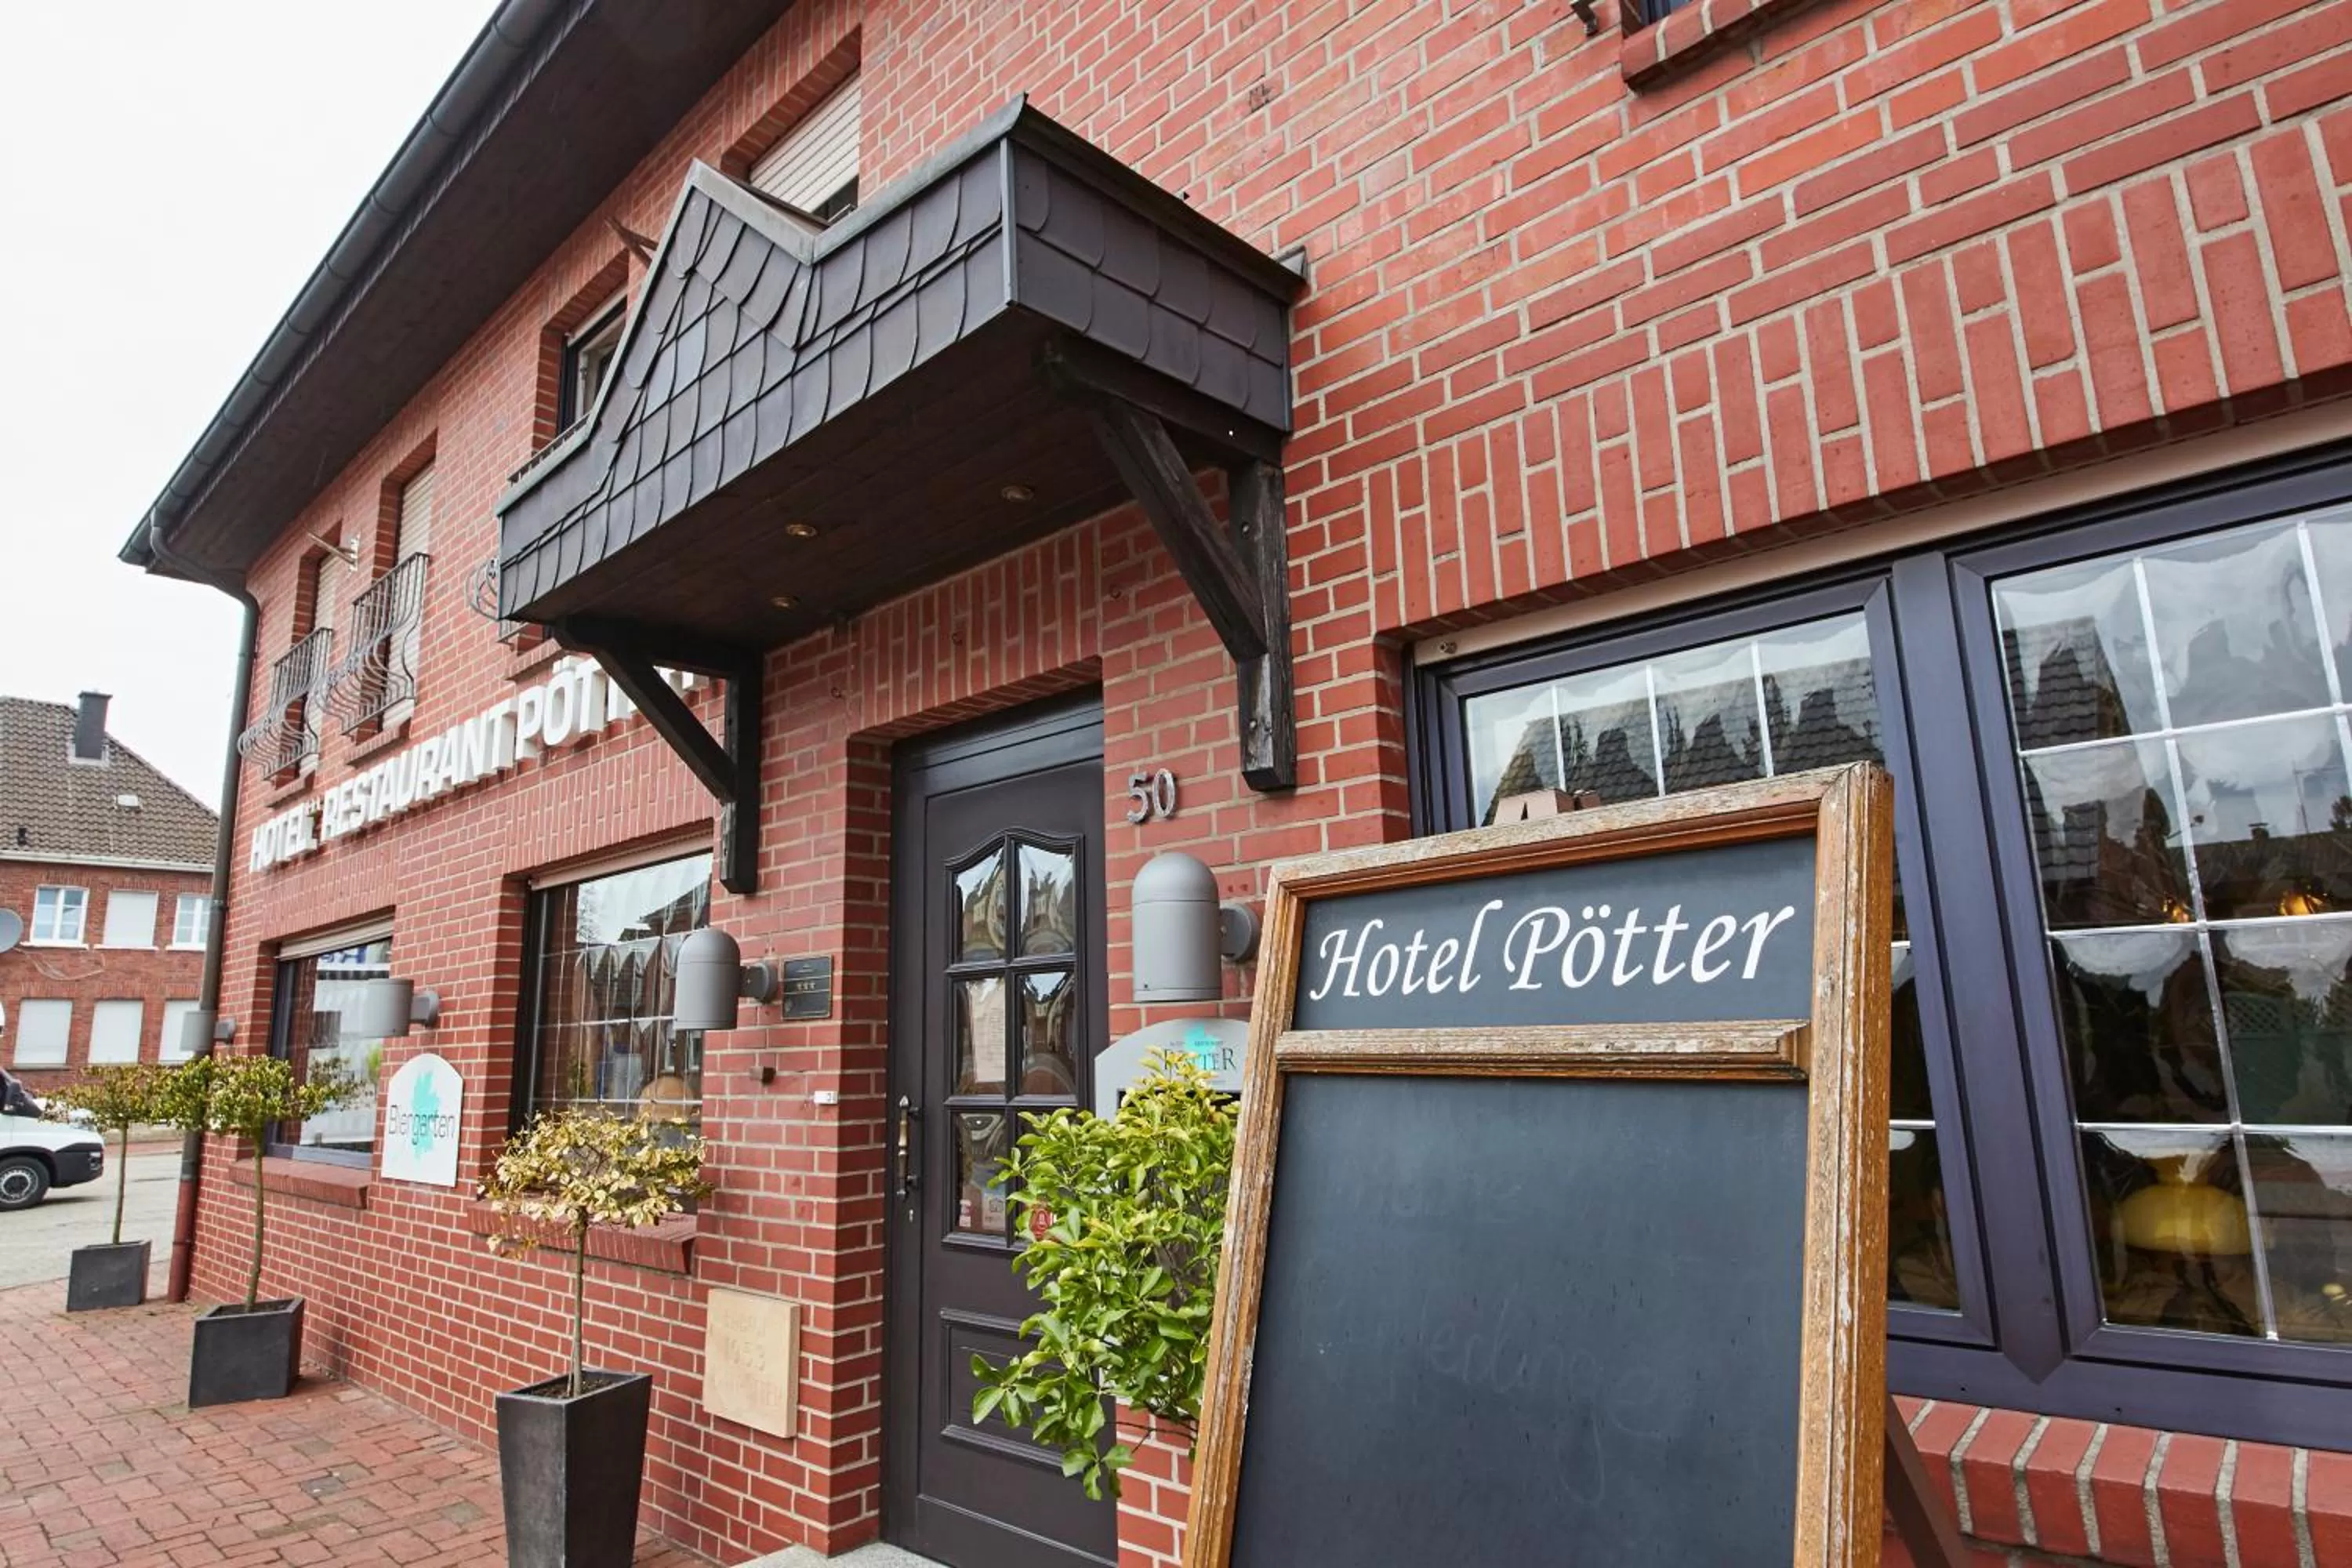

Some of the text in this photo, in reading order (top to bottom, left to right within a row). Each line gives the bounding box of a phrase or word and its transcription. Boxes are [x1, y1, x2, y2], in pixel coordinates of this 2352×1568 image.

[249, 802, 317, 873] HOTEL
[321, 697, 517, 842] RESTAURANT
[1127, 768, 1175, 822] 50
[1309, 898, 1795, 1001] Hotel Pötter
[388, 1104, 457, 1145] Biergarten
